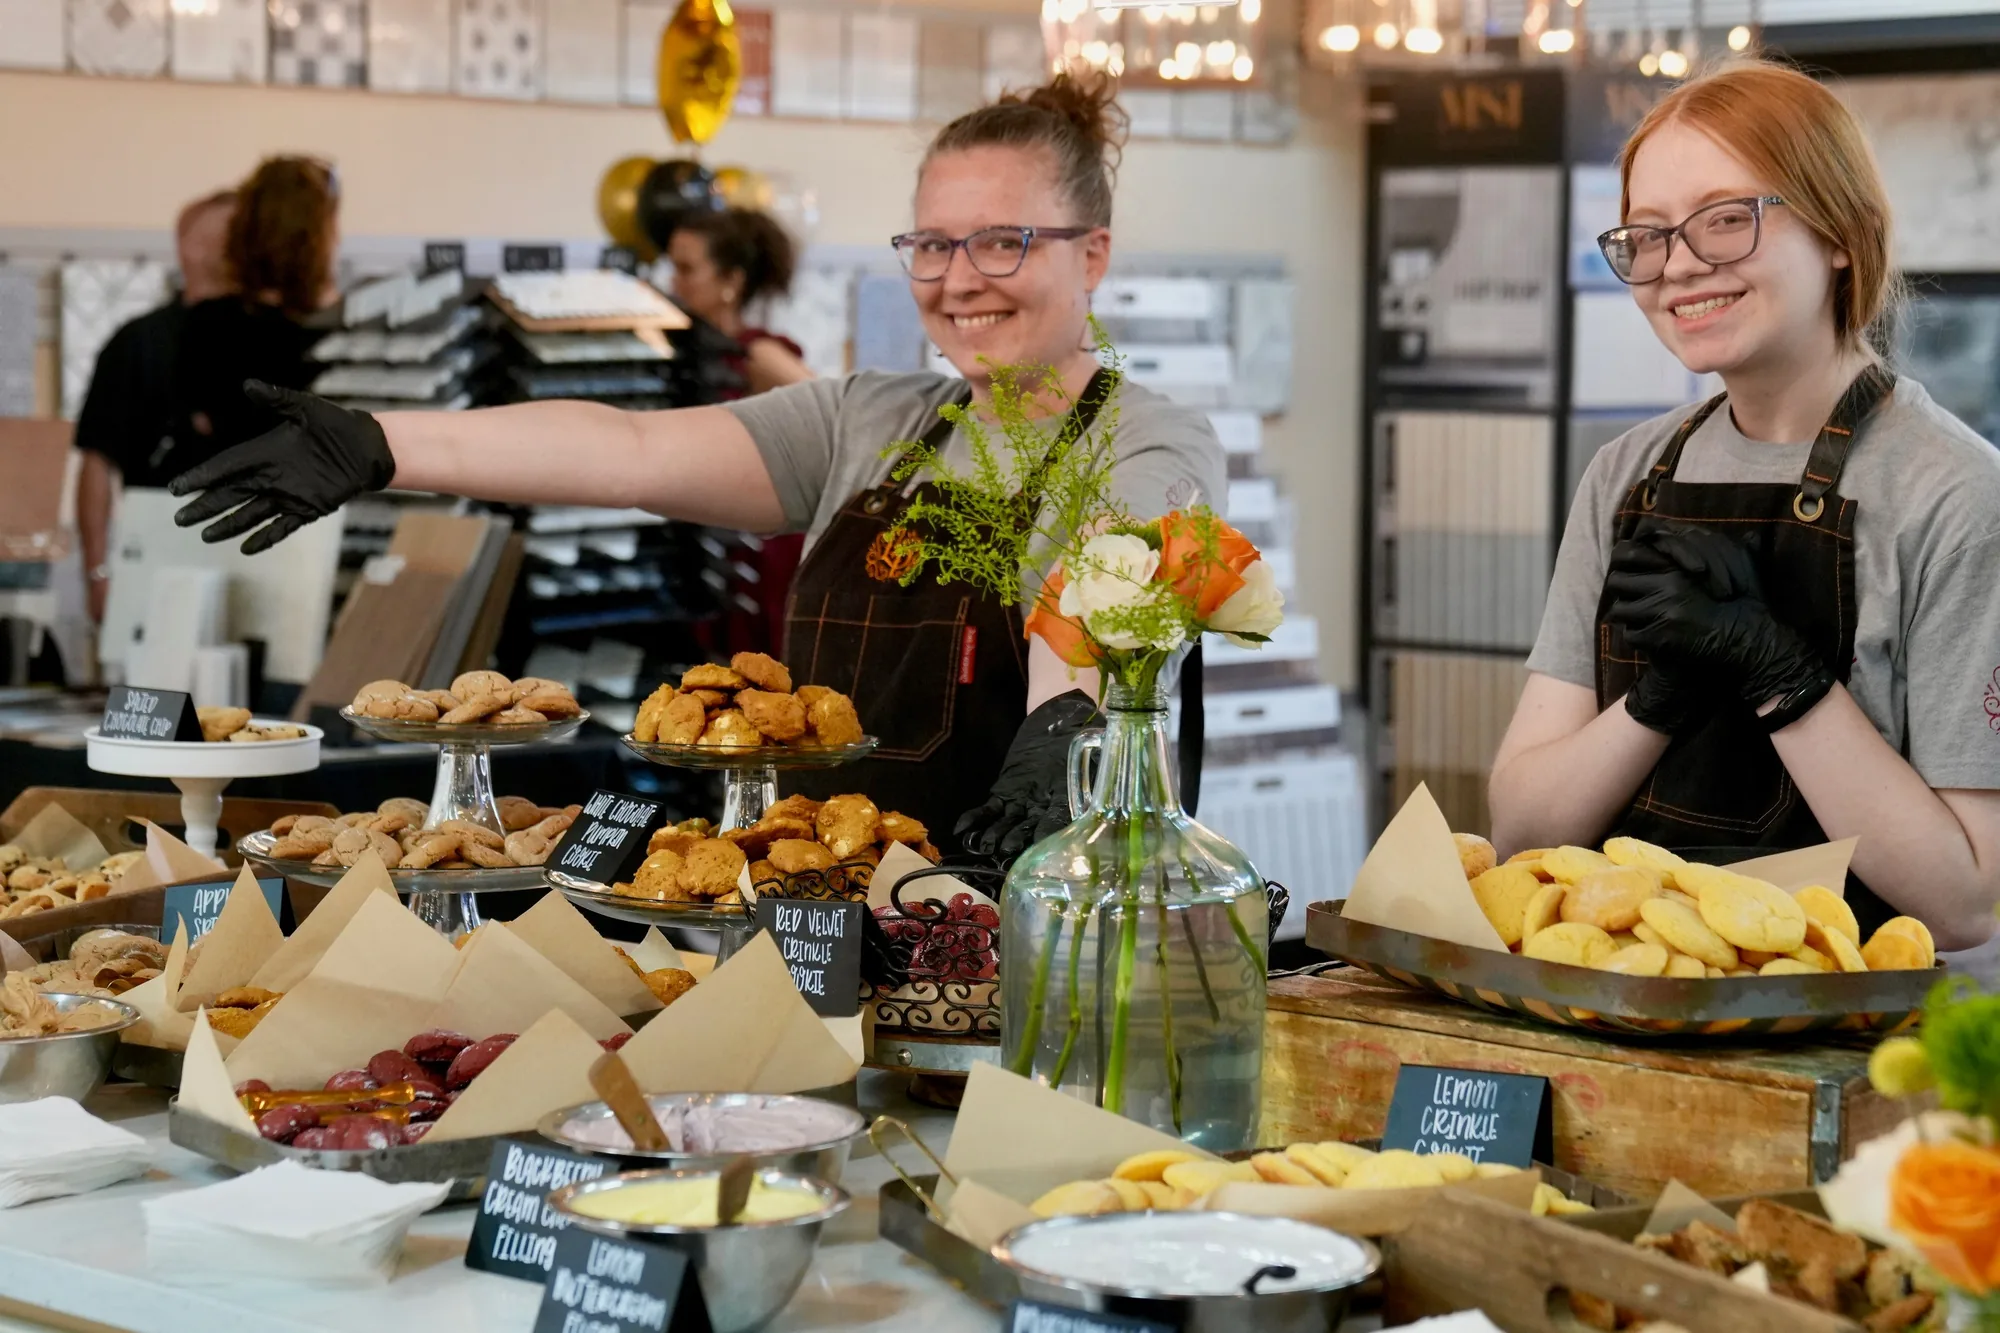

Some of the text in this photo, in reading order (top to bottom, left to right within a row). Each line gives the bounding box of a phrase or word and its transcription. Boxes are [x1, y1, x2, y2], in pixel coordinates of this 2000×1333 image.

[580, 821, 629, 850] PUMPKIN
[560, 843, 602, 872] COOKIE
[775, 903, 847, 939] RED VELVET
[783, 936, 833, 965] CRINKLE
[789, 963, 826, 996] OOKIE
[1433, 1072, 1498, 1110] LEMON
[1420, 1105, 1500, 1142] CRINKLE
[483, 1179, 541, 1225] CREAM
[492, 1223, 558, 1272] FILLING
